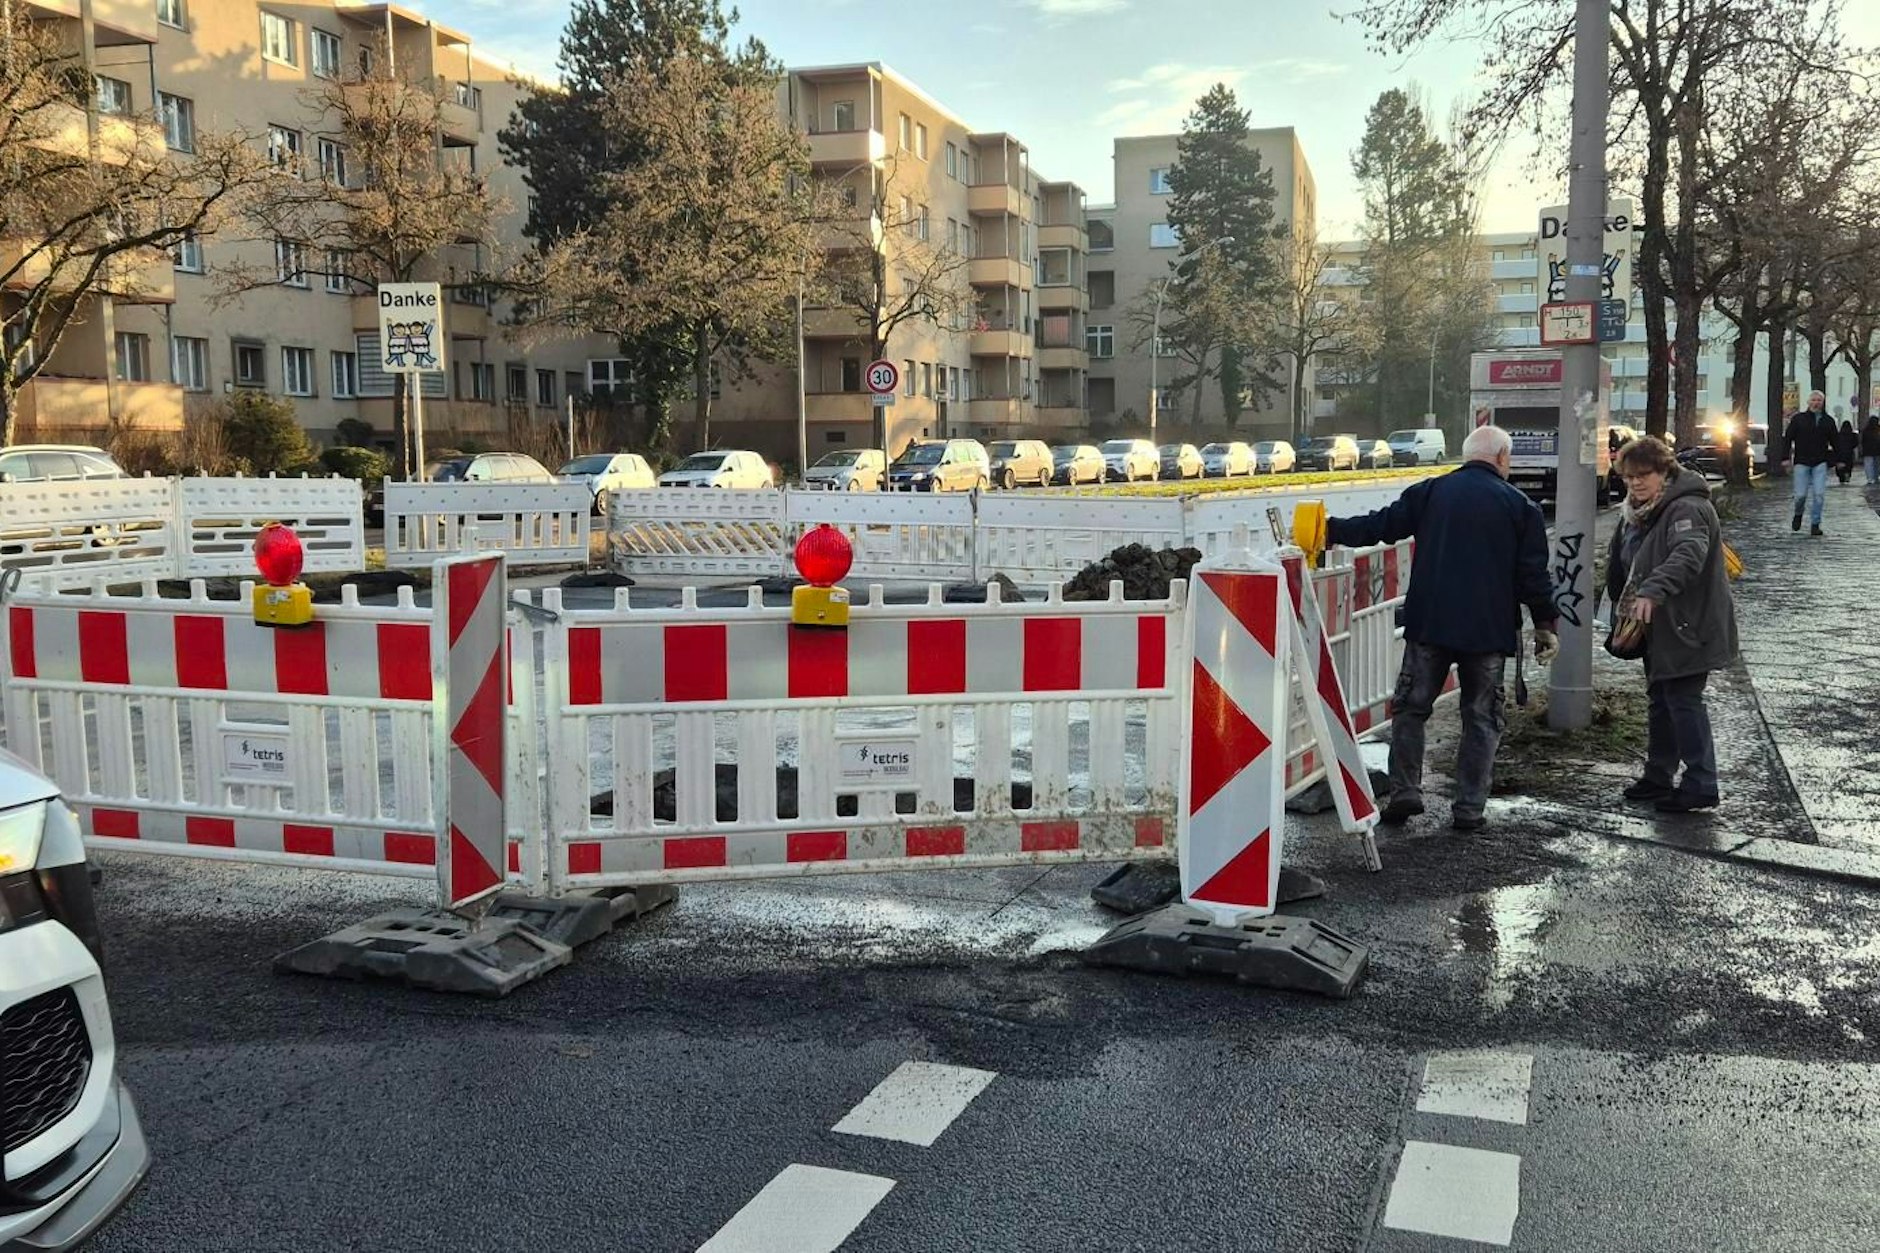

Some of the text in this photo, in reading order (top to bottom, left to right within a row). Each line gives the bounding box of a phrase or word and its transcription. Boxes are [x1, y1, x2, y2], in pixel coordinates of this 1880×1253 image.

[380, 291, 436, 306] Danke
[872, 370, 892, 385] 30
[1500, 364, 1555, 378] ARNDT
[253, 748, 284, 761] tetris
[873, 752, 909, 764] tetris
